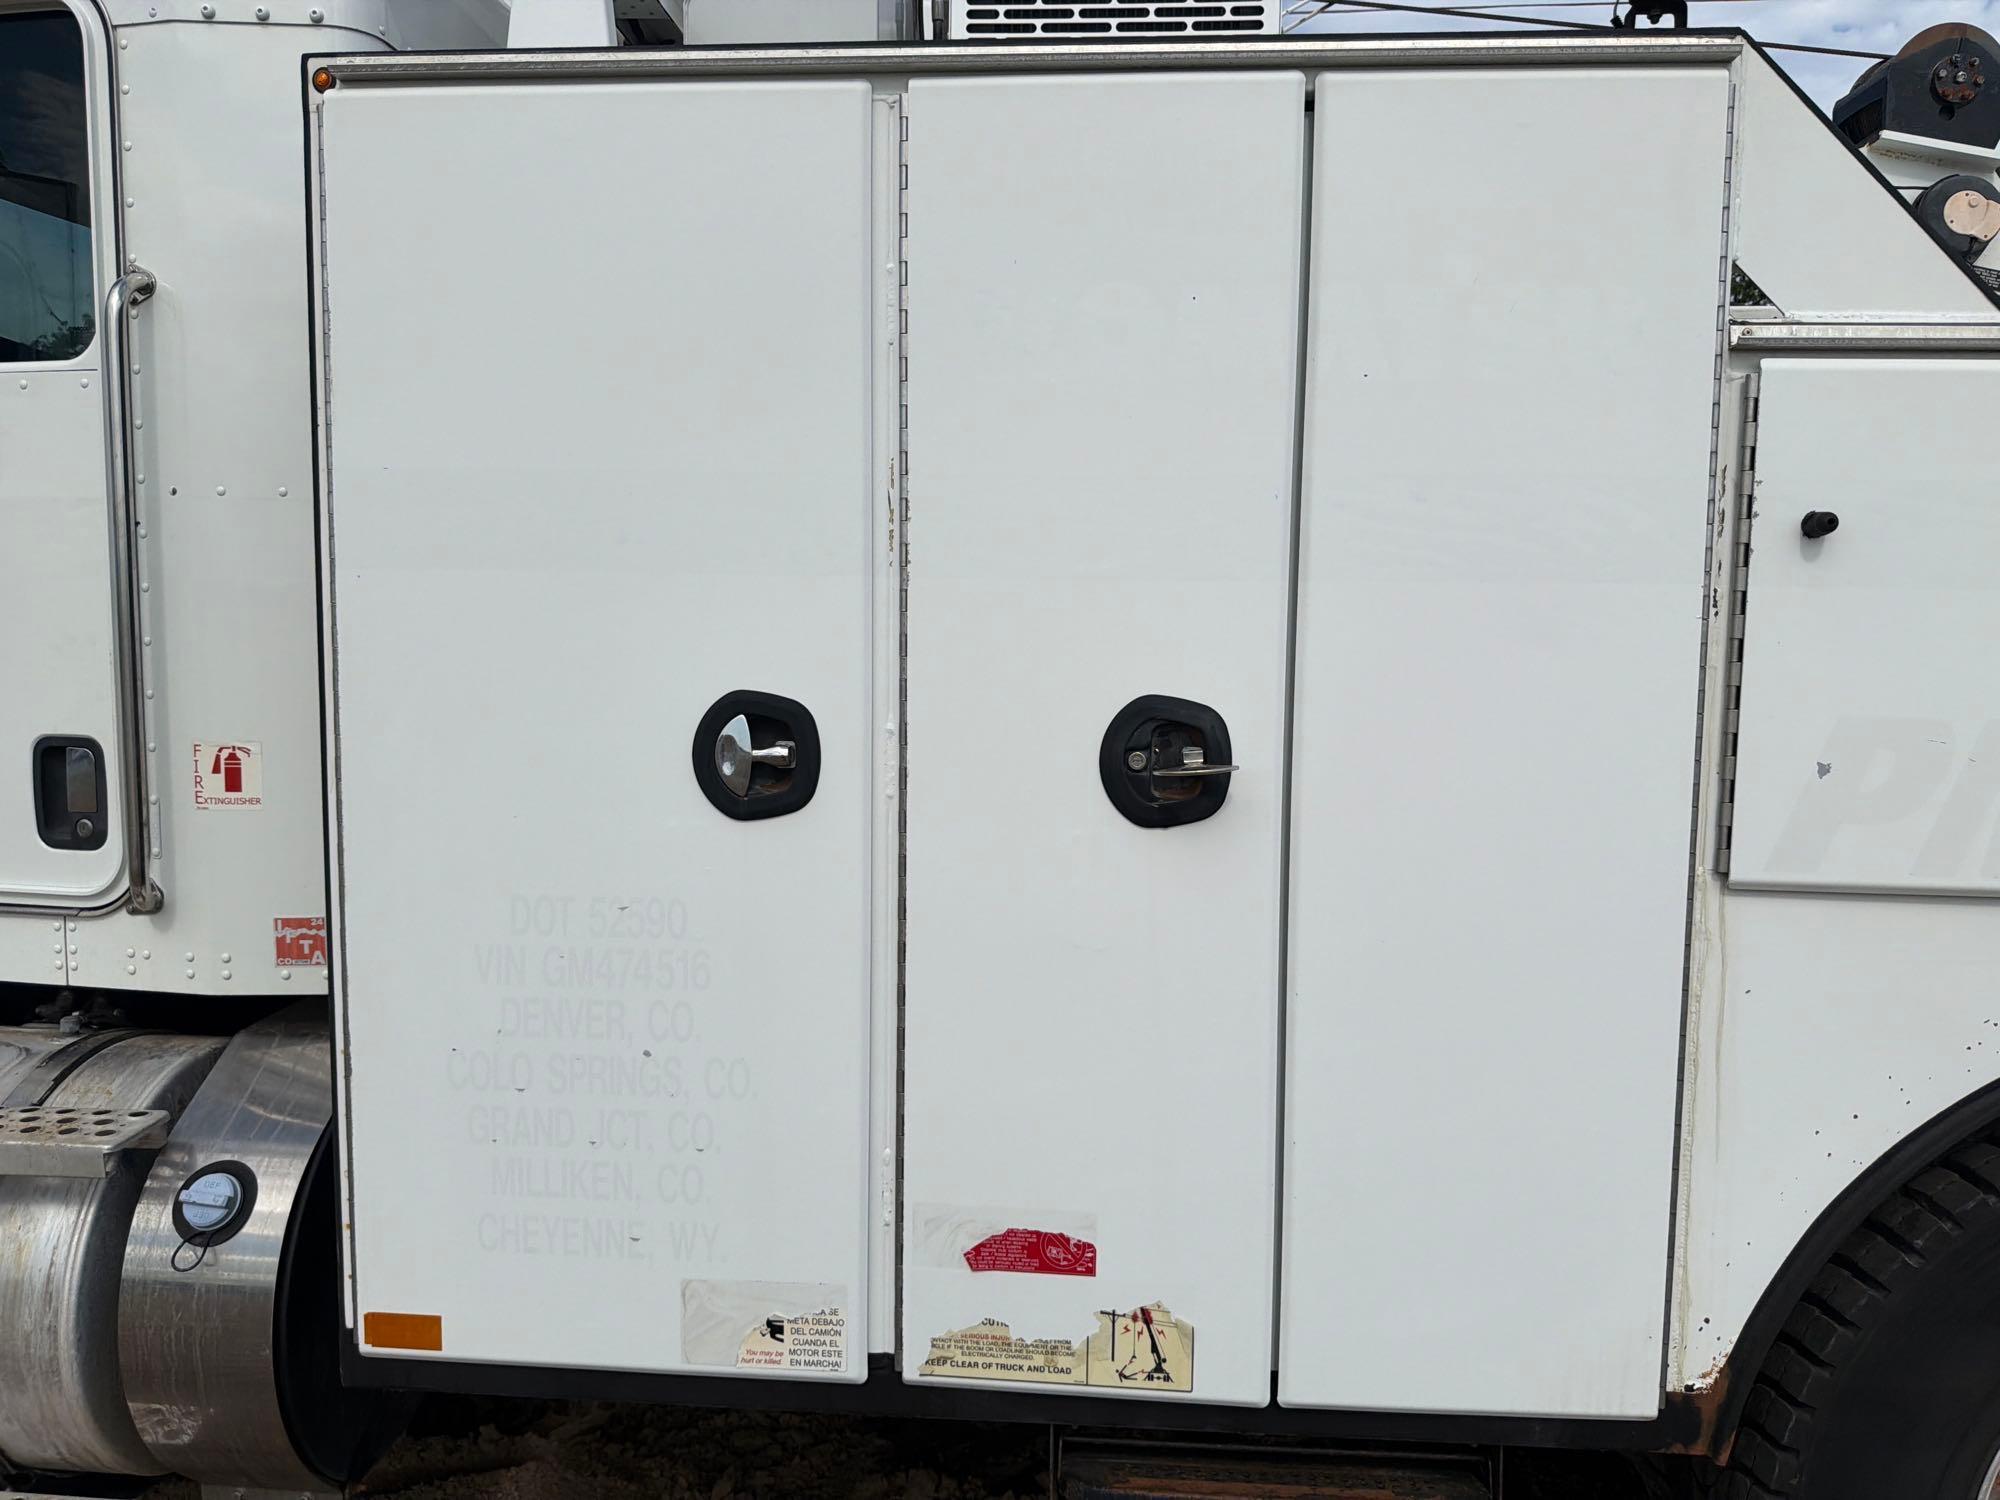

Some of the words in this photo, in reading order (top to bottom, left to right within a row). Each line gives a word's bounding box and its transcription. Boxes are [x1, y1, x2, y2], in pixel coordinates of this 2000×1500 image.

[193, 744, 205, 805] FIRE
[511, 894, 576, 938] DOT
[588, 896, 689, 941] 52590
[473, 943, 526, 987] VIN
[542, 946, 712, 992] GM474516
[501, 996, 634, 1048] DENVER,
[446, 1050, 534, 1092] COLO
[704, 1056, 760, 1101] CO.
[468, 1103, 576, 1149] GRAND
[668, 1111, 723, 1155] CO.
[477, 1212, 656, 1269] CHEYENNE,
[669, 1220, 729, 1264] WY.
[790, 1327, 807, 1336] DEL
[811, 1318, 845, 1327] DEBAJO
[759, 1350, 774, 1358] may
[788, 1348, 820, 1358] MOTOR
[821, 1350, 843, 1359] ESTE
[792, 1338, 828, 1348] CUANDA
[829, 1339, 840, 1348] EL
[789, 1358, 802, 1367] EN
[925, 1358, 948, 1368] KEEP
[949, 1360, 980, 1370] CLEAR
[981, 1361, 995, 1370] OF
[995, 1362, 1025, 1373] TRUCK
[1026, 1365, 1046, 1374] AND
[1047, 1367, 1073, 1376] LOAD
